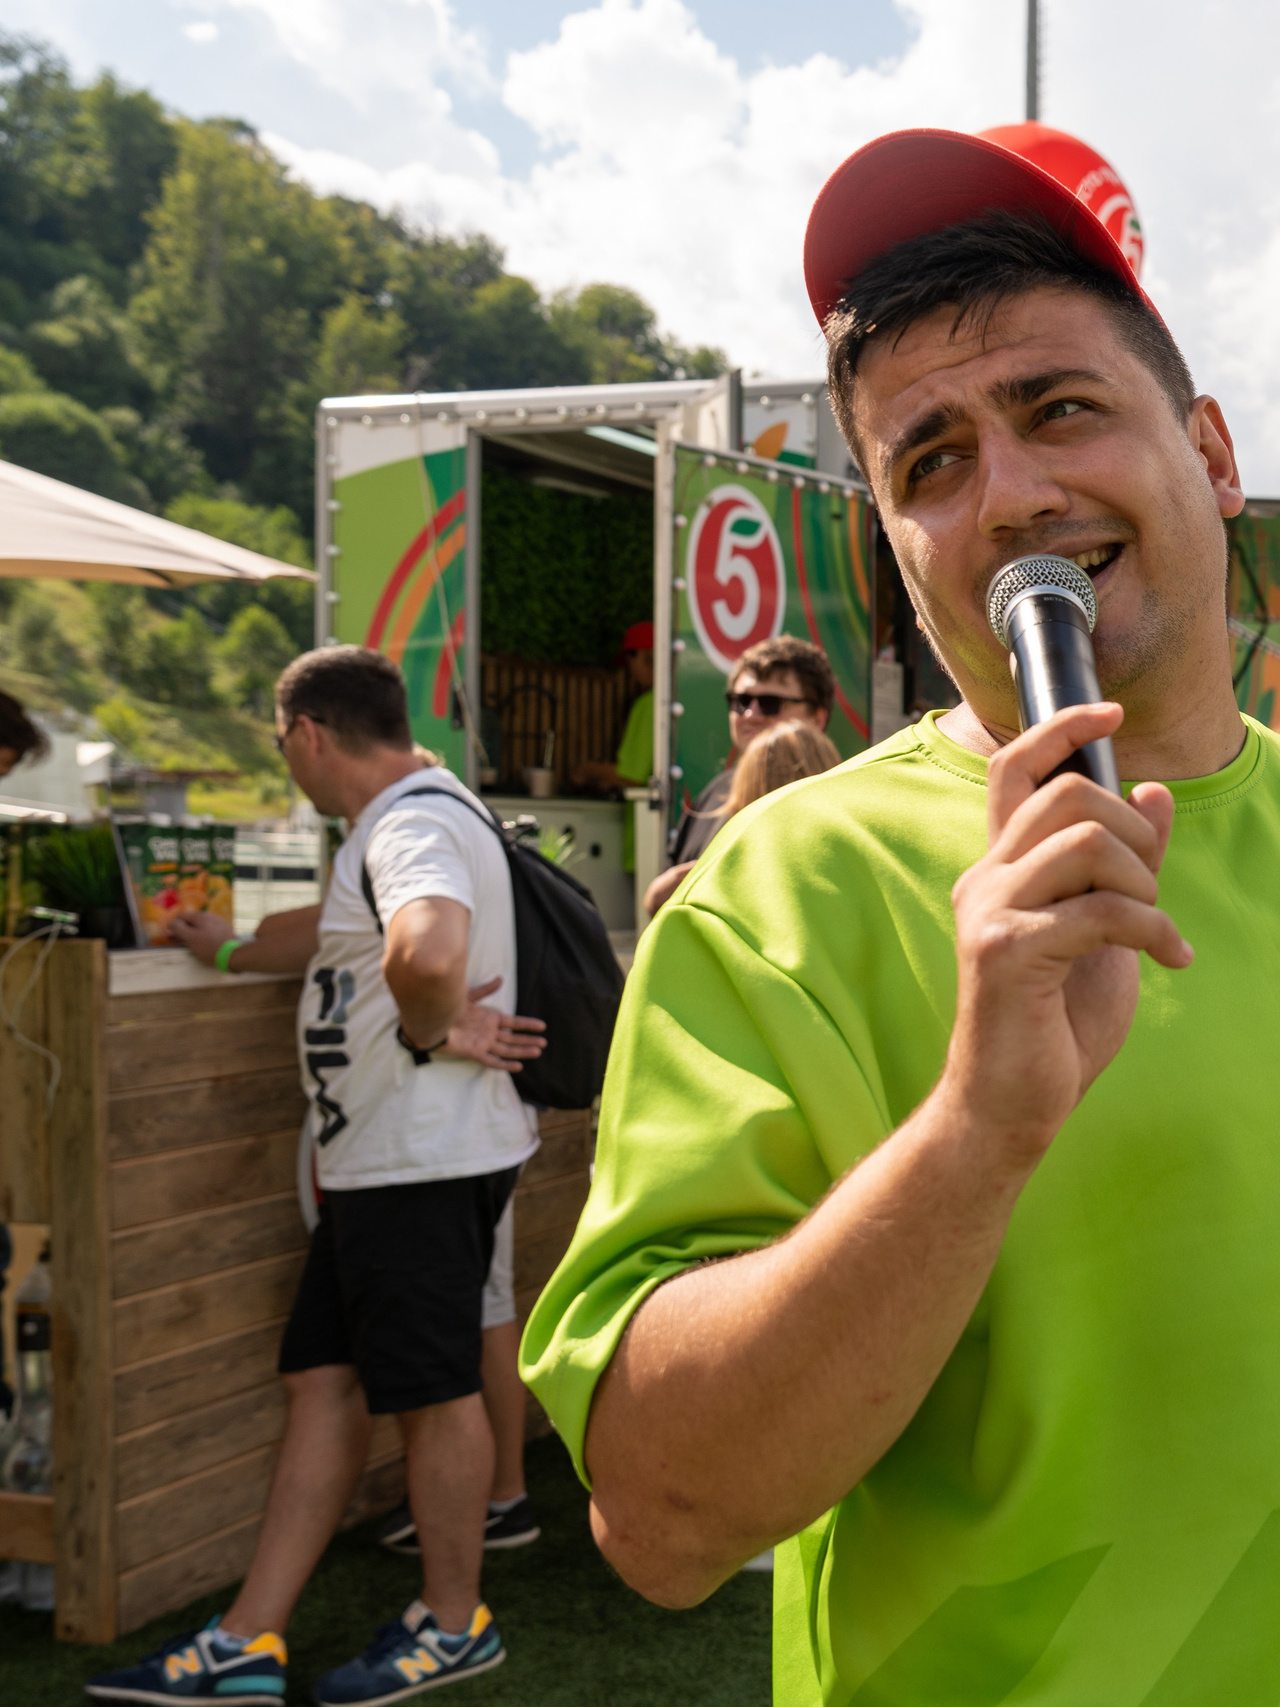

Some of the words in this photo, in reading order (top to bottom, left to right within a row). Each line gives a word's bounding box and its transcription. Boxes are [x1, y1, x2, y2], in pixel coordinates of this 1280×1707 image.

[712, 506, 768, 641] 5
[305, 968, 356, 1147] FILA
[164, 1648, 202, 1682] N
[395, 1649, 439, 1682] N
